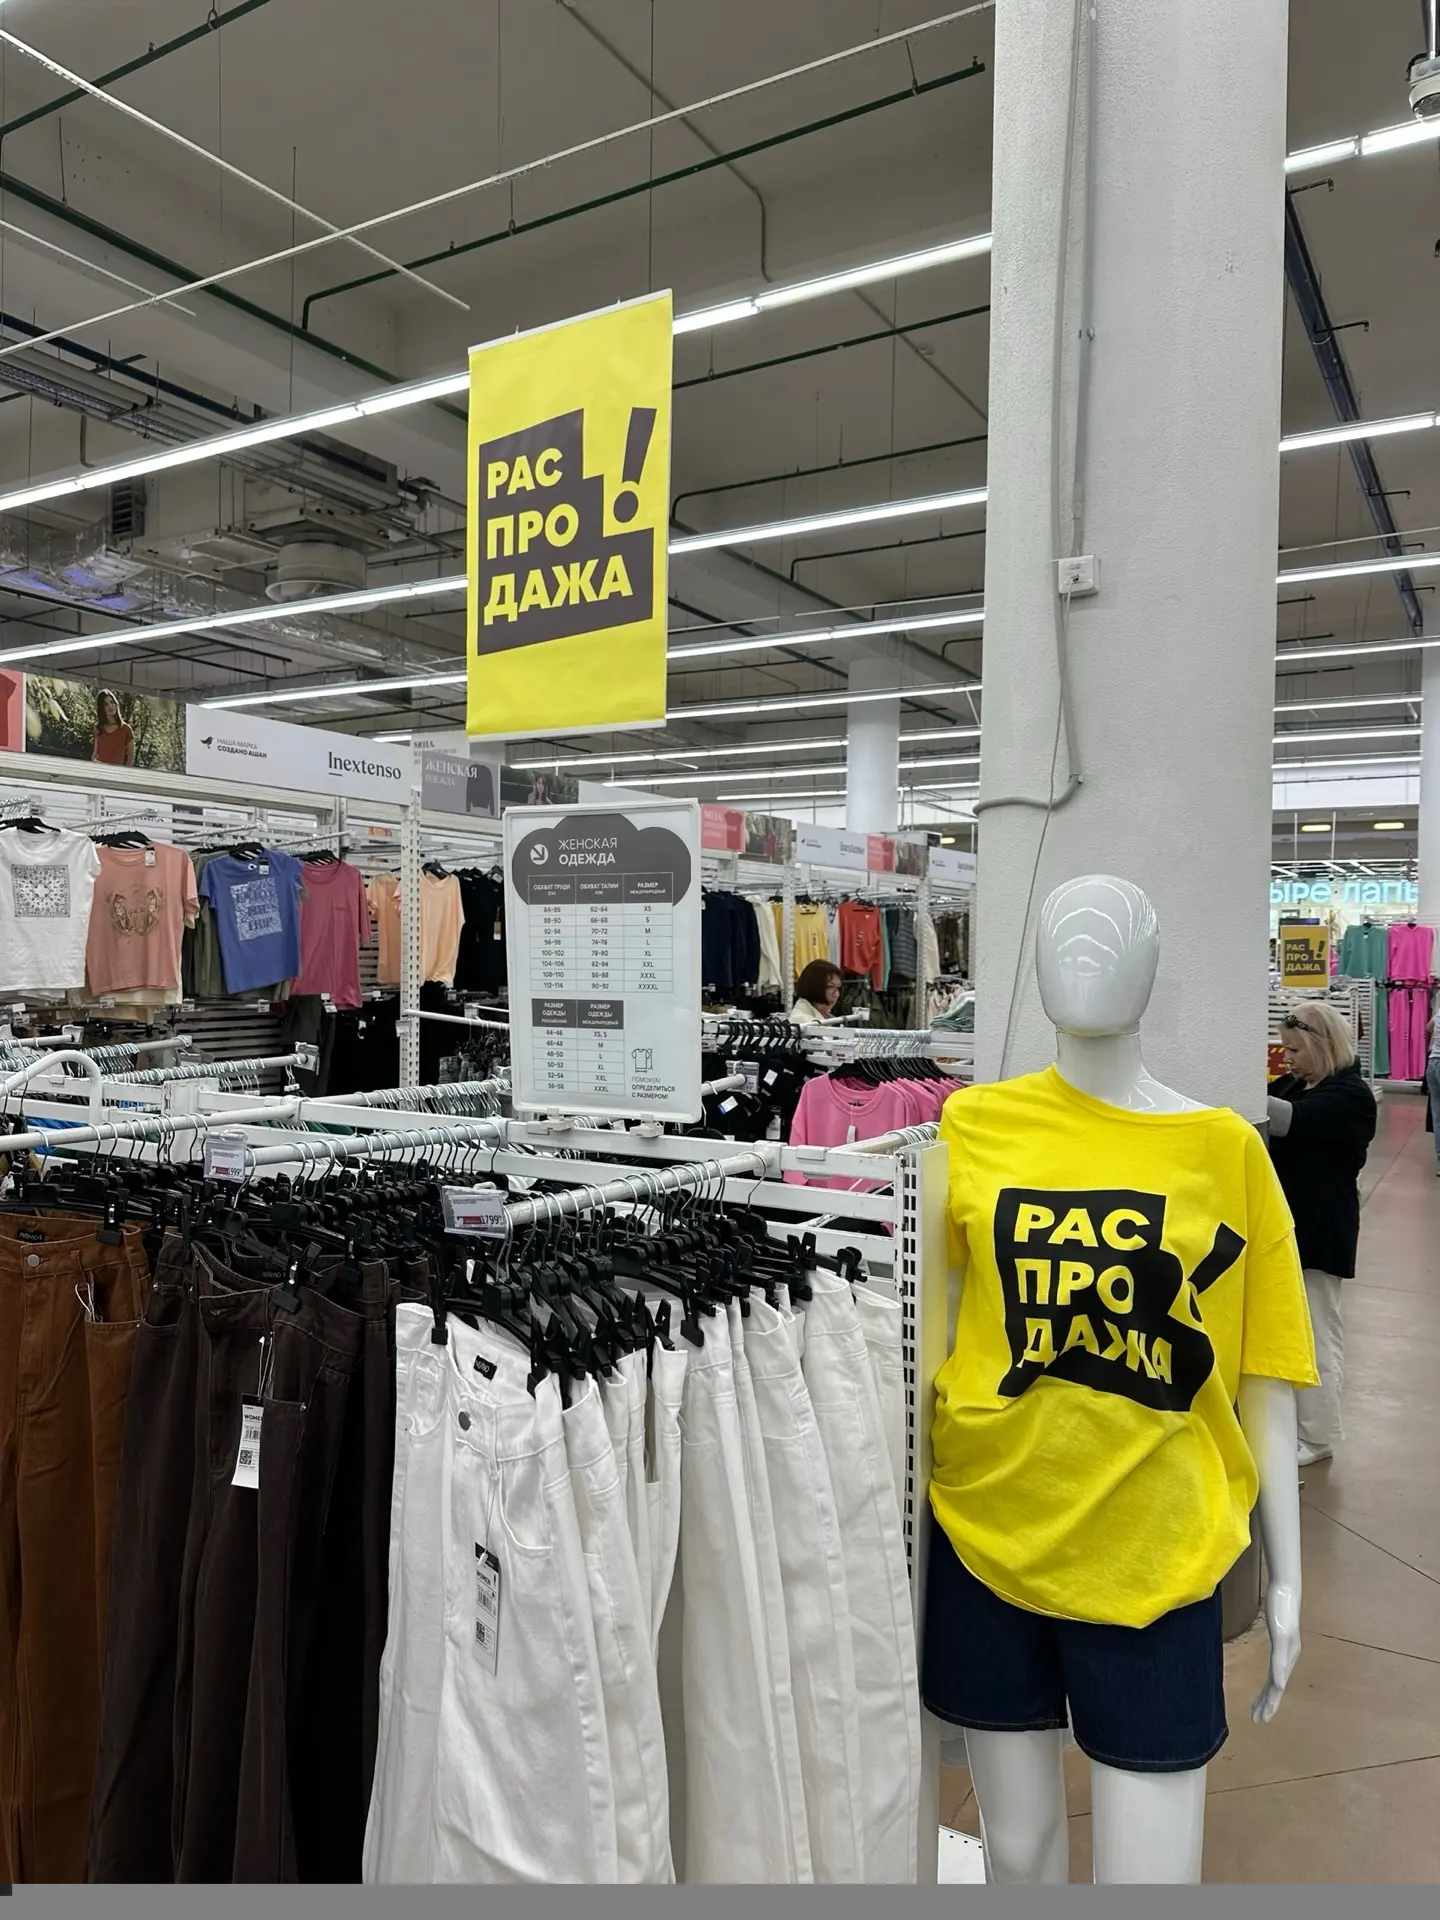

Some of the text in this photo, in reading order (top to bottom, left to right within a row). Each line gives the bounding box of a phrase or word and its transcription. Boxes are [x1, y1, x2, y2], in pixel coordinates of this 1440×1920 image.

[487, 447, 563, 499] РАС
[487, 503, 579, 560] ПРО
[484, 554, 633, 626] ДАЖА
[217, 745, 267, 758] СОЗДАНО АШАН
[328, 751, 402, 780] Inextenso
[425, 760, 478, 778] ЖЕНСКАЯ
[558, 837, 618, 850] ЖЕНСКАЯ
[558, 852, 616, 867] ОДЕЖДА
[554, 883, 571, 891] ГРУДИ
[601, 882, 619, 890] ТАЛИИ
[1286, 943, 1306, 951] РАС
[1286, 952, 1309, 961] ПРО
[1285, 963, 1321, 972] ДАЖА
[546, 1039, 563, 1047] 46-48
[547, 1050, 564, 1058] 48-50
[547, 1061, 564, 1069] 50-52
[548, 1082, 564, 1090] 56-58
[631, 1084, 676, 1092] ОПРЕДЕЛИТЬСЯ
[637, 1092, 669, 1100] РАЗМЕРОМ!
[1013, 1202, 1151, 1251] РАС
[1014, 1258, 1135, 1315] ПРО
[1015, 1313, 1173, 1385] ДАЖА
